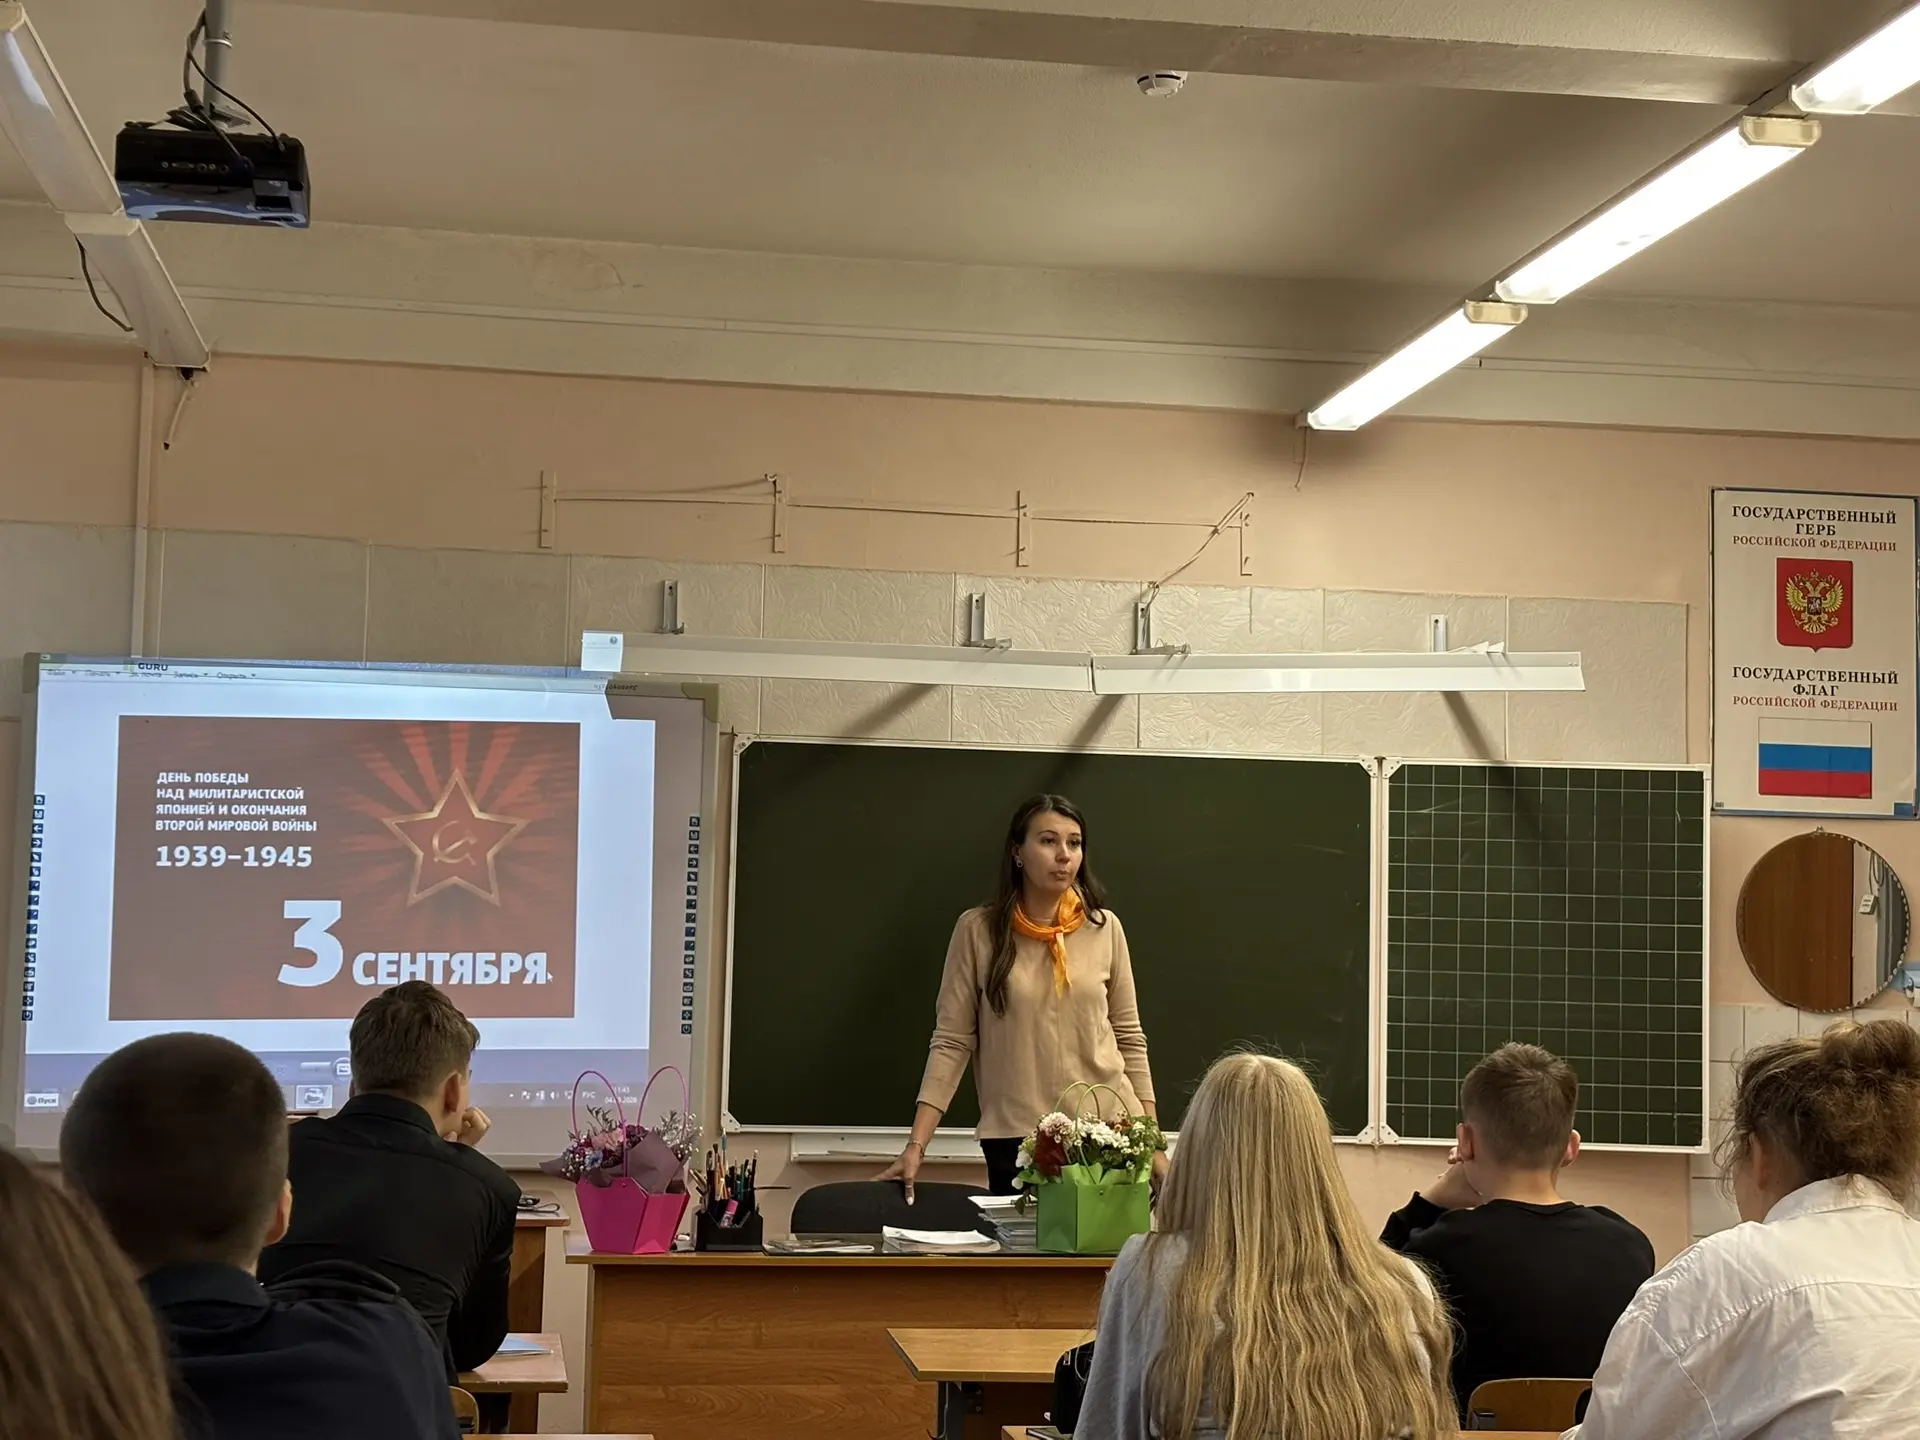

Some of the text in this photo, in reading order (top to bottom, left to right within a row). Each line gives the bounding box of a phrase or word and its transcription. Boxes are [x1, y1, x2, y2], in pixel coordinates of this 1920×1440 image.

[1732, 505, 1897, 524] ГОСУДАРСТВЕННЫЙ
[1795, 523, 1836, 536] ГЕРБ
[1733, 535, 1897, 552] РОССИЙСКОЙ ФЕДЕРАЦИИ
[138, 662, 169, 671] GURU
[1733, 666, 1898, 685] ГОСУДАРСТВЕННЫЙ
[1792, 684, 1839, 697] ФЛАГ
[1733, 696, 1898, 713] РОССИЙСКОЙ ФЕДЕРАЦИИ
[156, 772, 249, 785] ДЕНЬ ПОБЕДЫ
[156, 786, 304, 800] НАД МИЛИТАРИСТСКОЙ
[156, 802, 307, 816] ЯПОНИЕЙ И ОКОНЧАНИЯ
[155, 817, 317, 832] ВТОРОЙ МИРОВОЙ ВОЙНЫ
[277, 899, 547, 987] 3 СЕНТЯБРЯ
